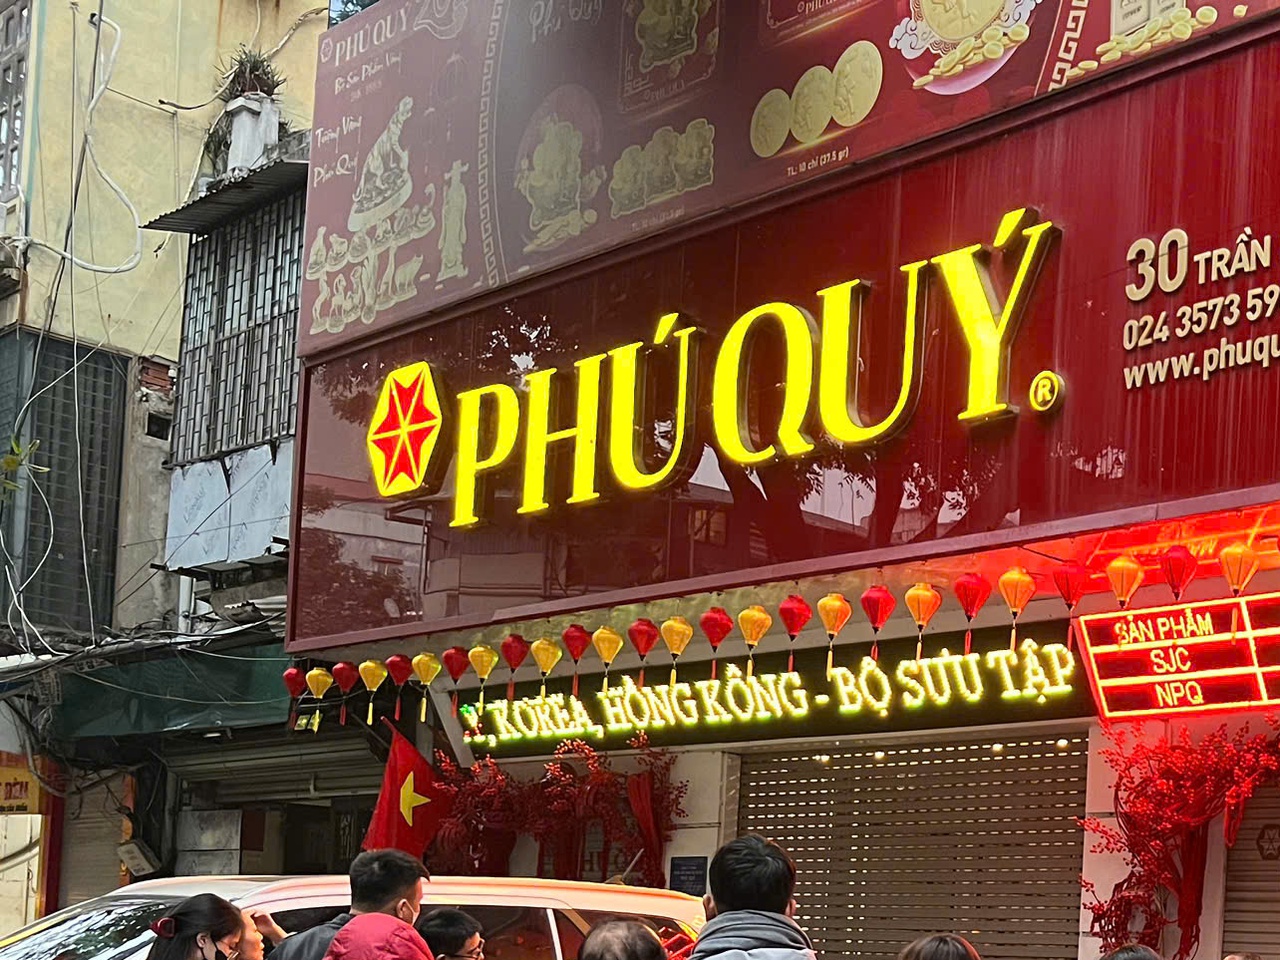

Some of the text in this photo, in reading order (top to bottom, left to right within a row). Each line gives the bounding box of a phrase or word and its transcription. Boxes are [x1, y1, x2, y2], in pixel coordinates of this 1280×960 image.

[1124, 227, 1189, 302] 30
[1193, 225, 1272, 285] TRẦN
[1123, 310, 1169, 351] 024
[1175, 293, 1241, 339] 3573
[449, 311, 699, 528] PHÚ
[711, 206, 1053, 466] QUÝ
[1114, 606, 1214, 645] SẢN PHẨM
[694, 662, 809, 718] KÔNG
[830, 655, 893, 717] BỘ
[985, 637, 1076, 704] TẬP
[1150, 646, 1192, 674] SJC
[1154, 680, 1205, 707] NPQ
